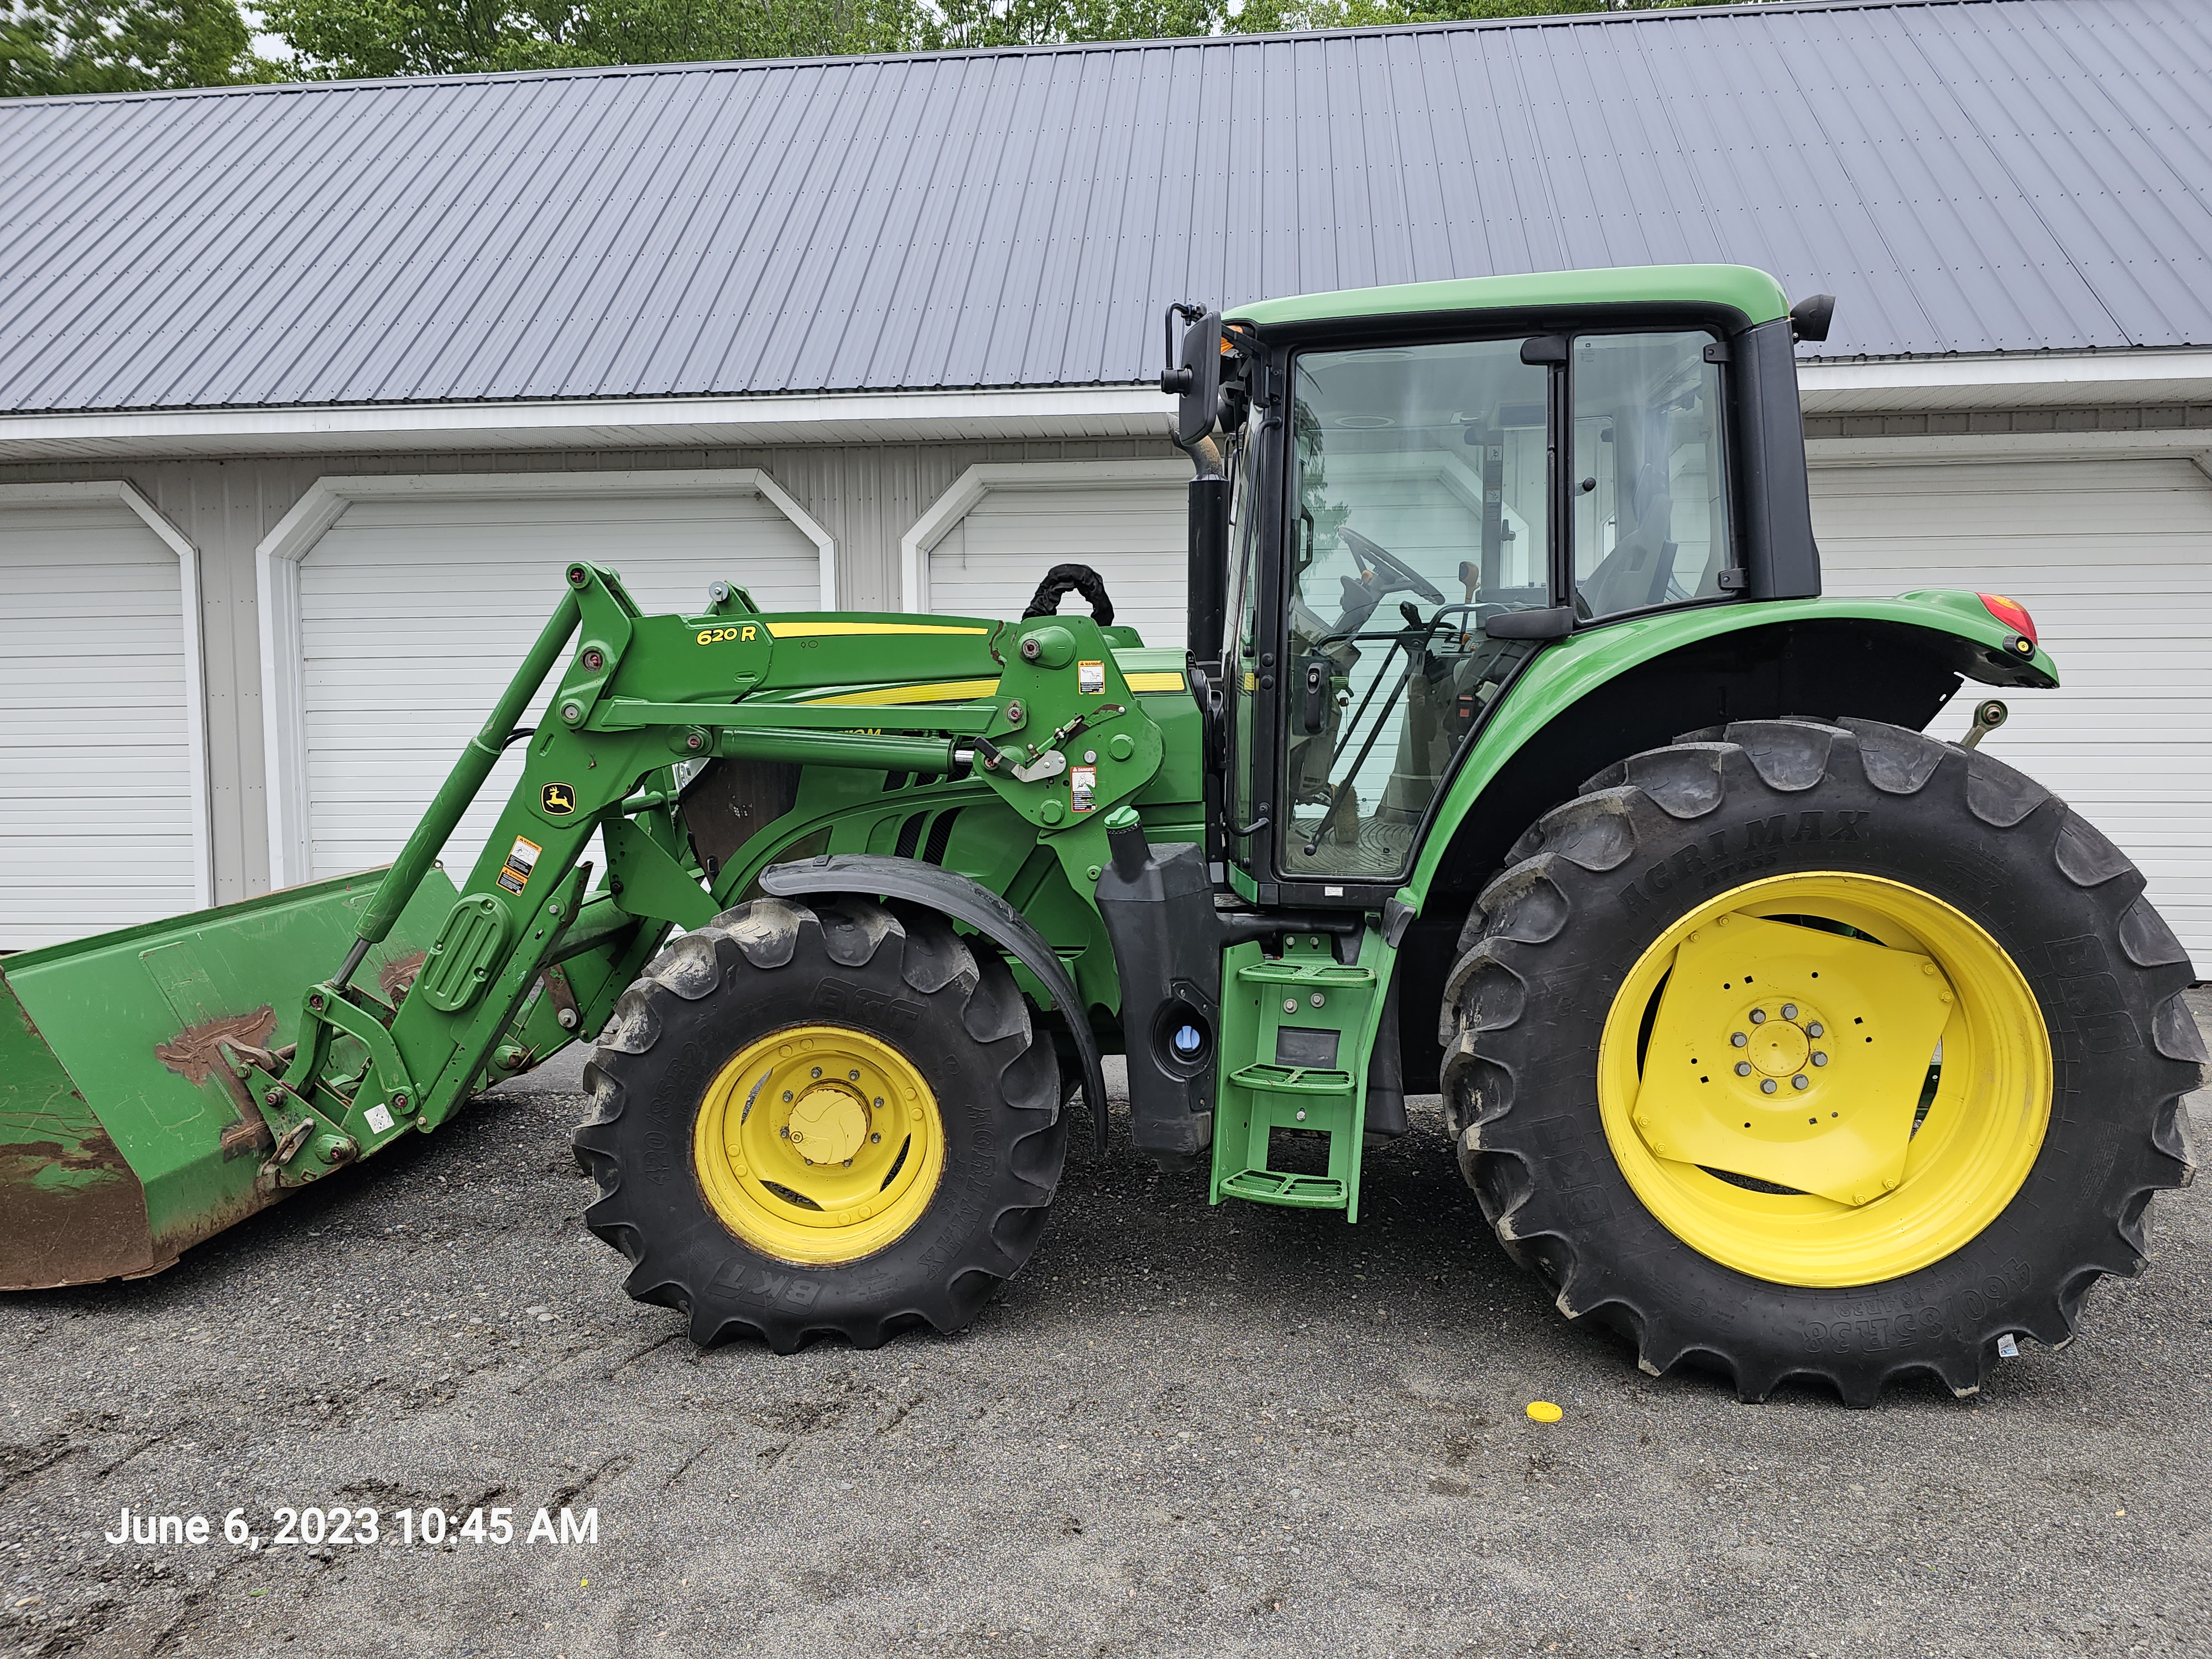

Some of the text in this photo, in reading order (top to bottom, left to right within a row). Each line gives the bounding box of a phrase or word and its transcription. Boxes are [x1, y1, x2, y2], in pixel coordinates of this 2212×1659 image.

[696, 625, 757, 646] 620 R
[1618, 810, 1871, 925] AGRI MAX
[917, 1104, 996, 1280] AGRI MAX
[714, 1264, 822, 1308] BKT
[1802, 1257, 2032, 1354] 460/85R38
